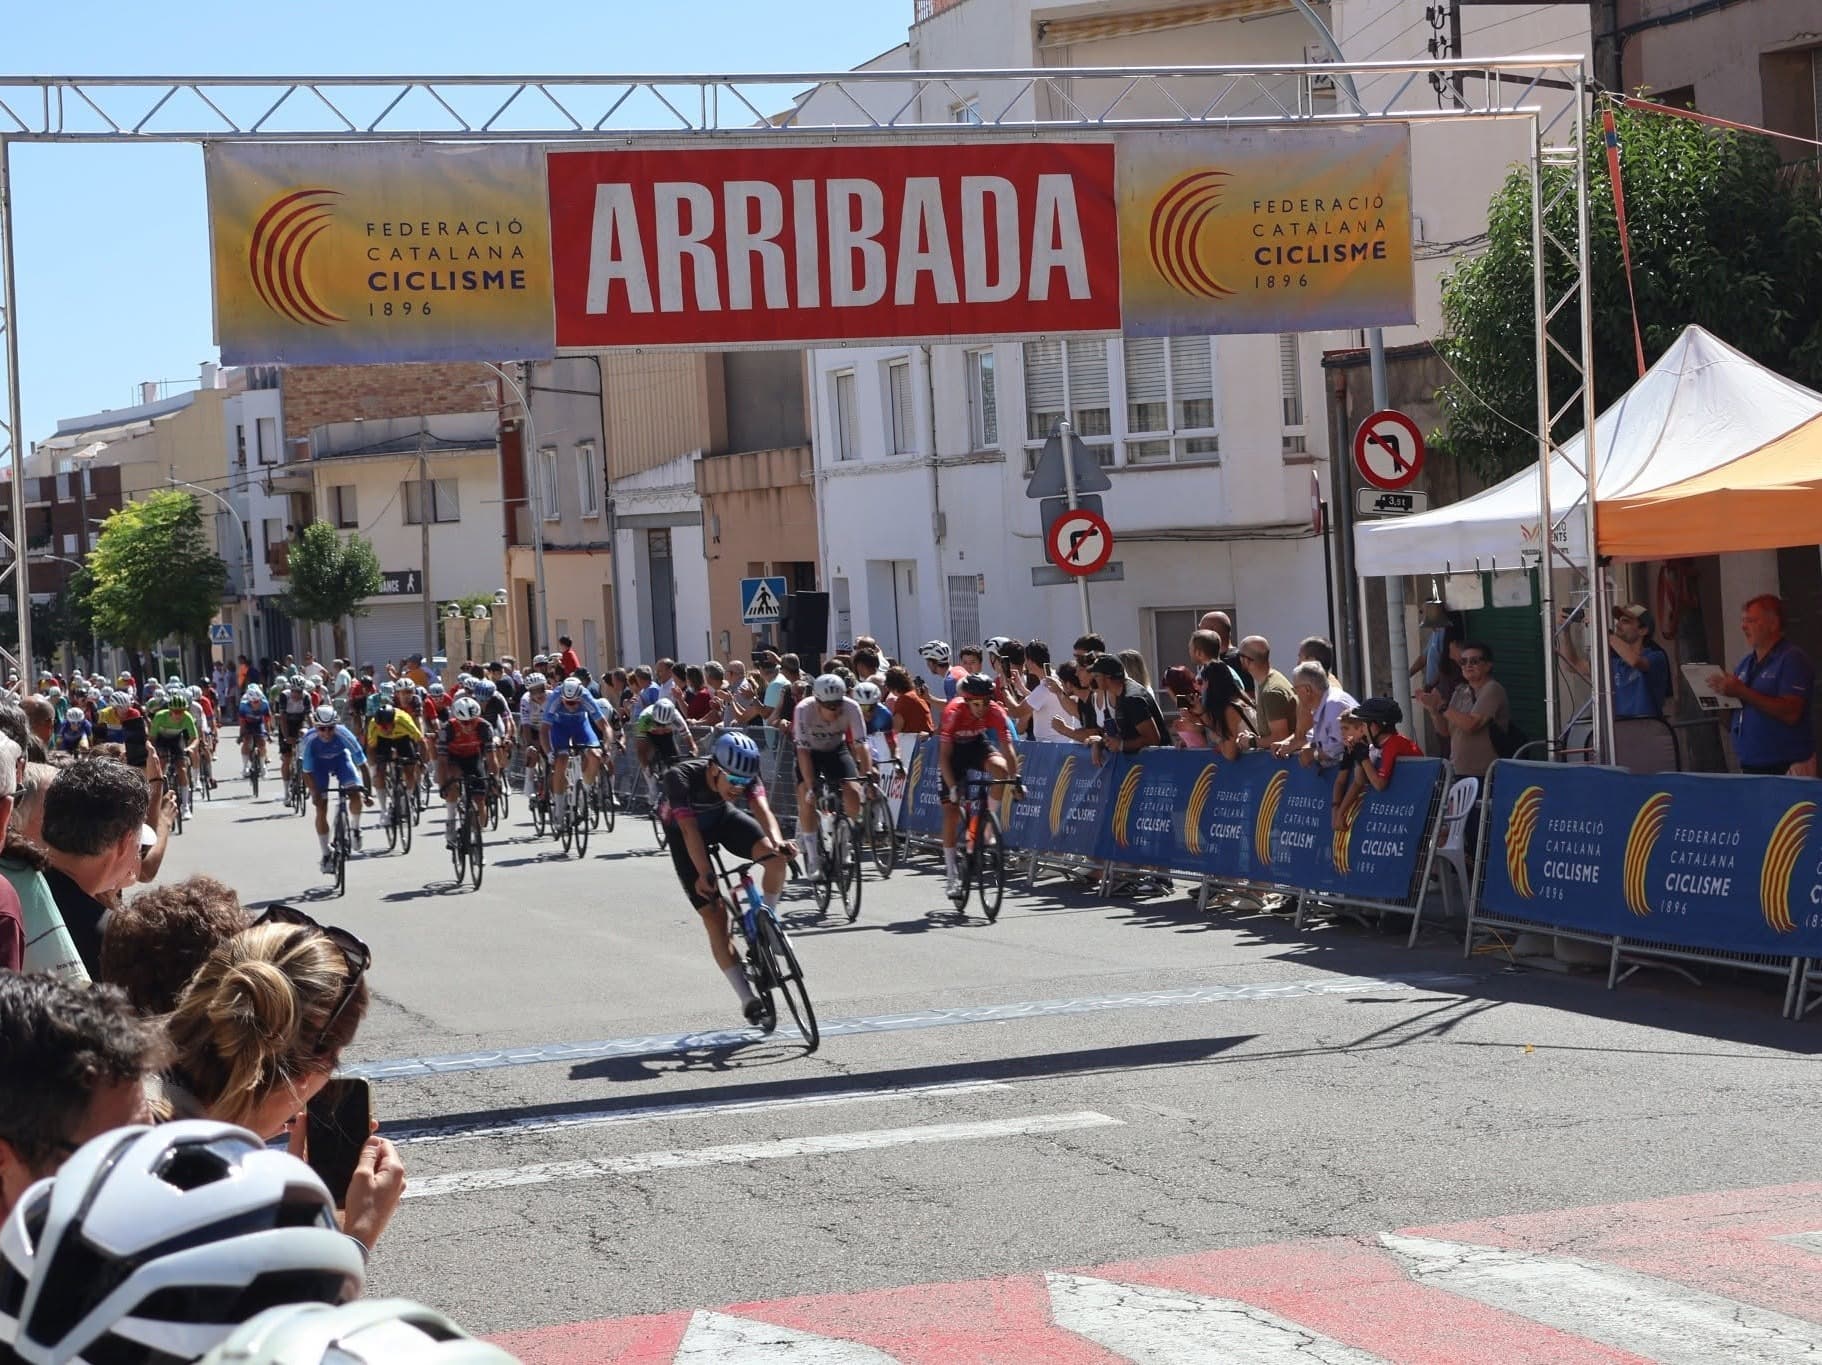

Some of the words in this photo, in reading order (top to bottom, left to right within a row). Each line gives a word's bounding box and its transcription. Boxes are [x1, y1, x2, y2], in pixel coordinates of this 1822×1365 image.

[1253, 195, 1384, 214] FEDERACIÓ
[367, 217, 523, 237] FEDERACIÓ
[1252, 218, 1386, 237] CATALANA
[367, 245, 525, 262] CATALANA
[586, 173, 1092, 315] ARRIBADA
[1254, 240, 1387, 266] CICLISME
[367, 269, 526, 292] CICLISME
[1254, 274, 1308, 289] 1896
[368, 301, 432, 317] 1896
[1136, 817, 1171, 832] CICLISME
[1280, 830, 1316, 849] CICLISM
[1674, 828, 1741, 847] FEDERACIÓ
[1545, 839, 1601, 857] CATALANA
[1670, 850, 1735, 869] CATALANA
[1543, 860, 1600, 884] CICLISME
[1665, 873, 1732, 897] CICLISME
[1660, 899, 1688, 915] 1896
